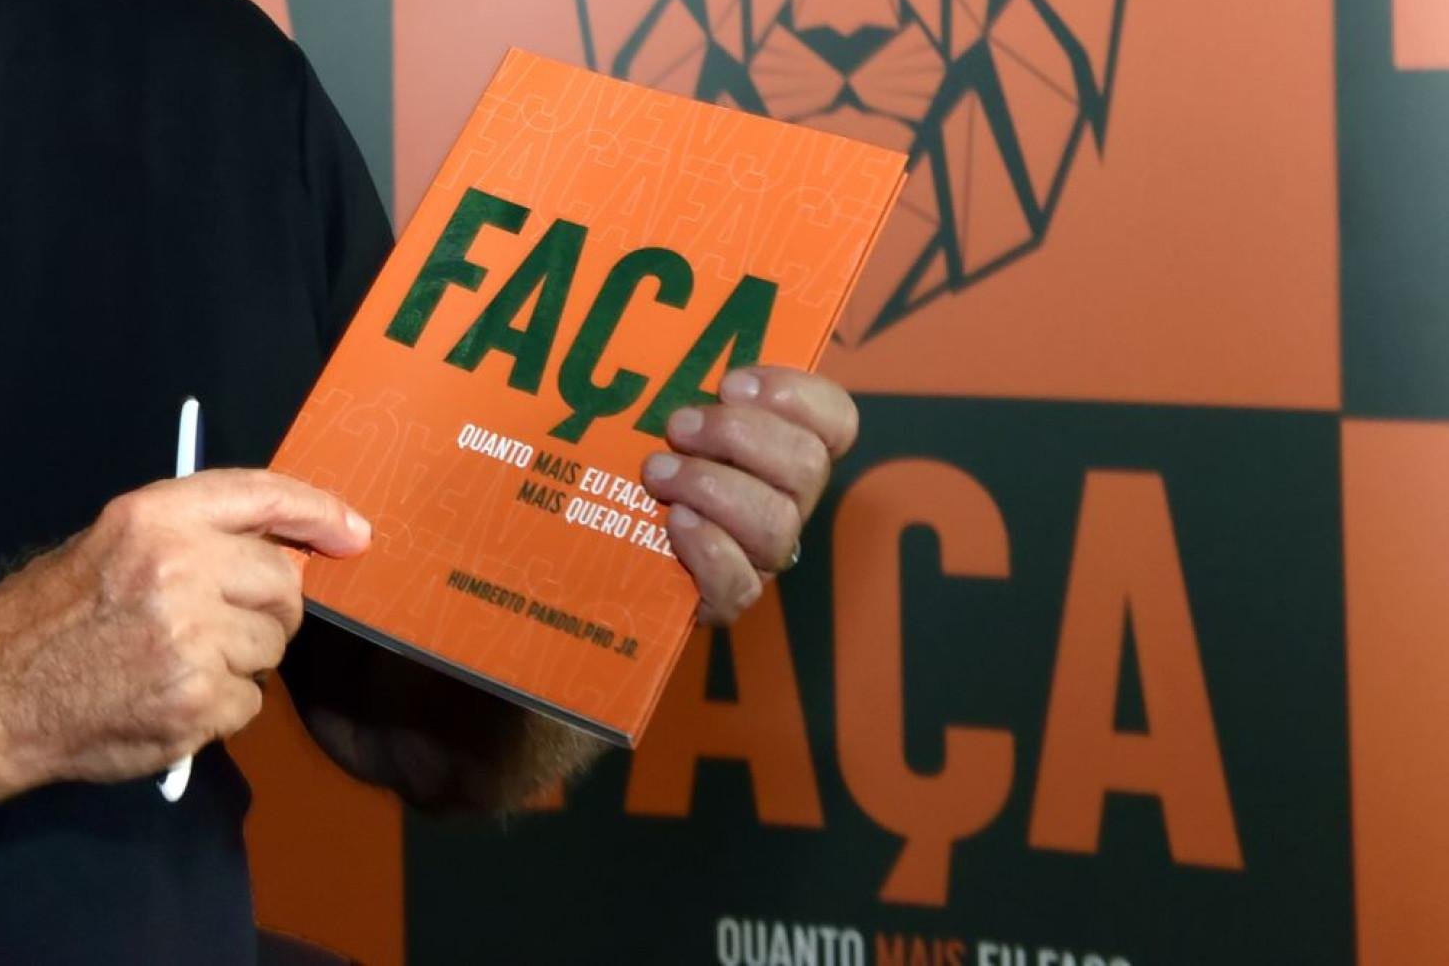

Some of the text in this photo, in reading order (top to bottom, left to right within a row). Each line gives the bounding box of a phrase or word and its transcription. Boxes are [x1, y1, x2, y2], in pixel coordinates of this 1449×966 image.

[384, 187, 779, 445] FAÇA
[457, 423, 534, 469] QUANTO
[531, 450, 581, 486] MAIS
[579, 467, 611, 496] EU
[516, 479, 567, 515] MAIS
[565, 497, 632, 539] QUERO
[447, 570, 526, 615] HUMBERTO
[526, 600, 615, 649] PANDOLPHO
[522, 456, 1244, 907] AÇA
[718, 918, 865, 966] QUANTO
